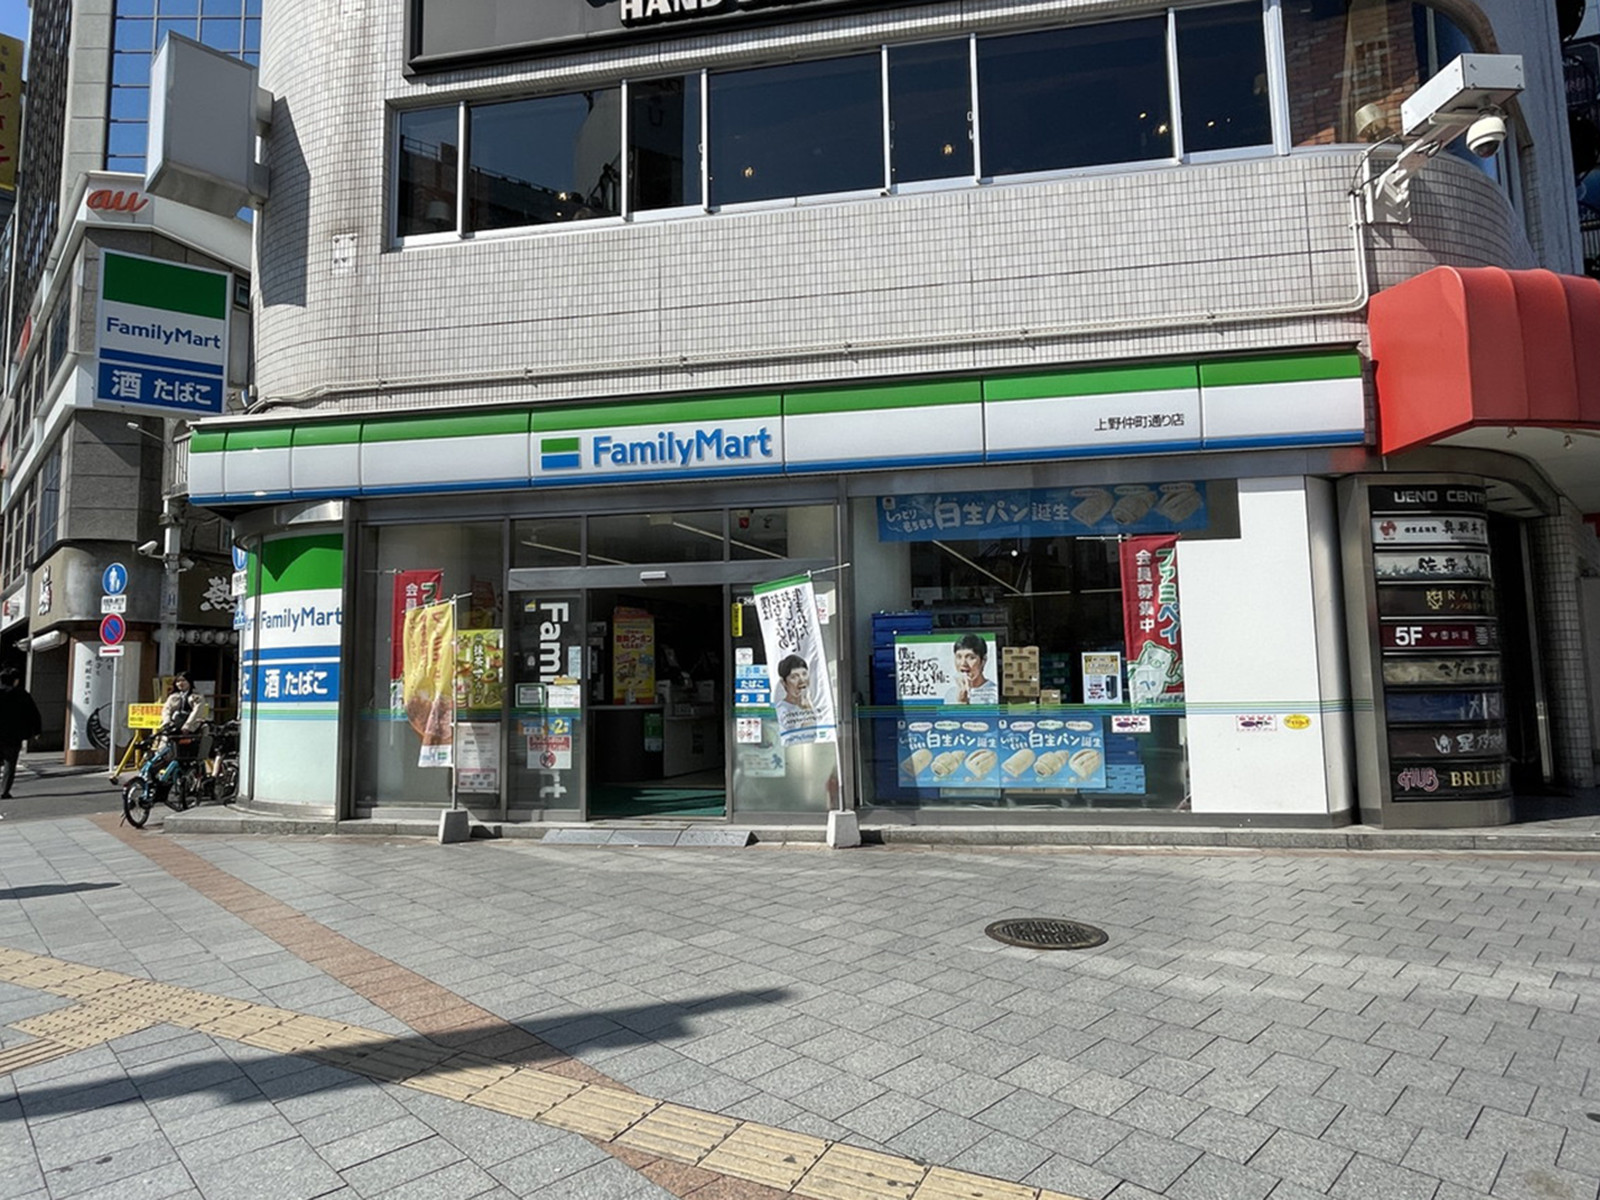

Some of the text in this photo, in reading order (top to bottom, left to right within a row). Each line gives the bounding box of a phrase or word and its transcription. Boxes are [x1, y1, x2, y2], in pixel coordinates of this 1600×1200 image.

[621, 0, 723, 20] HA
[87, 190, 149, 212] au
[106, 316, 221, 350] FamilyMart
[111, 369, 212, 405] 酒 たばこ
[1094, 413, 1185, 431] 上野仲町通り店
[593, 427, 774, 466] FamilyMart
[1394, 490, 1438, 503] UENO
[261, 606, 343, 633] FamilyMart
[1395, 627, 1423, 646] 5F
[264, 669, 281, 698] 酒
[285, 671, 328, 696] たばこ
[740, 680, 765, 688] たばこ
